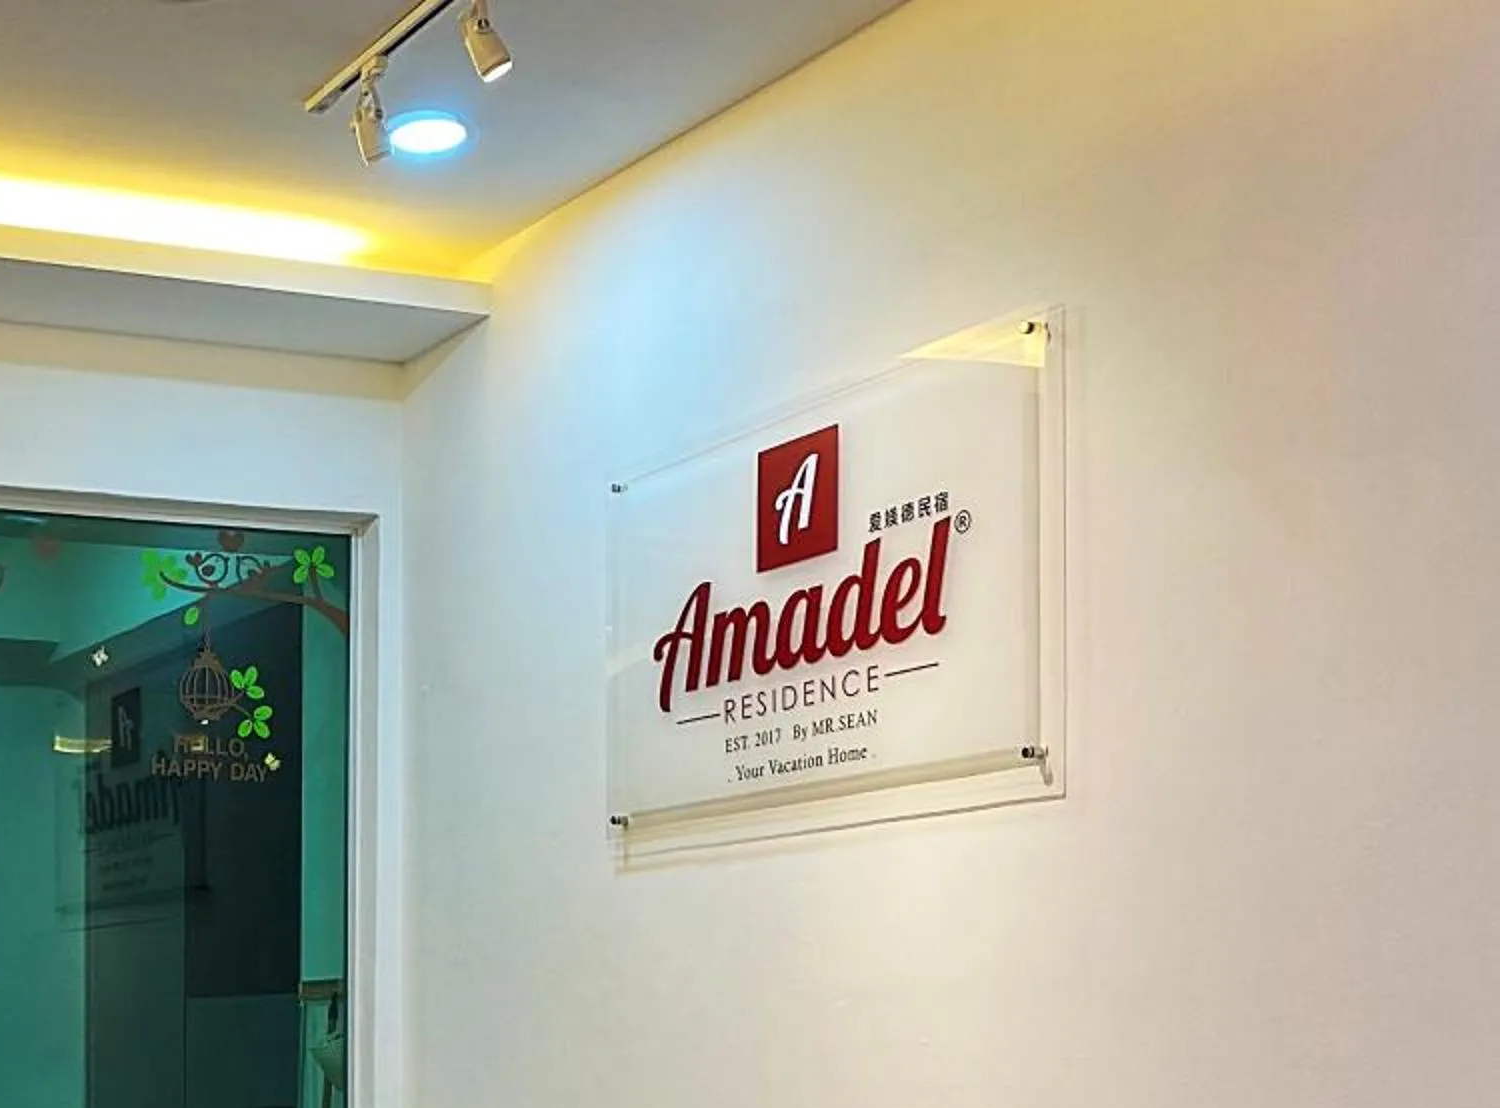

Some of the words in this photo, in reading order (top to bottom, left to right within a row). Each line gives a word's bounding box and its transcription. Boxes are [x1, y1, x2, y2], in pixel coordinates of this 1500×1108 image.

[775, 453, 819, 545] A
[653, 515, 951, 713] Amadel
[724, 665, 879, 724] RESIDENCE
[755, 727, 781, 746] 2017
[793, 723, 808, 742] By
[150, 754, 222, 782] HAPPY
[230, 762, 268, 783] DAY
[734, 764, 765, 781] Your
[768, 753, 823, 775] Vacation
[827, 747, 867, 765] Home
